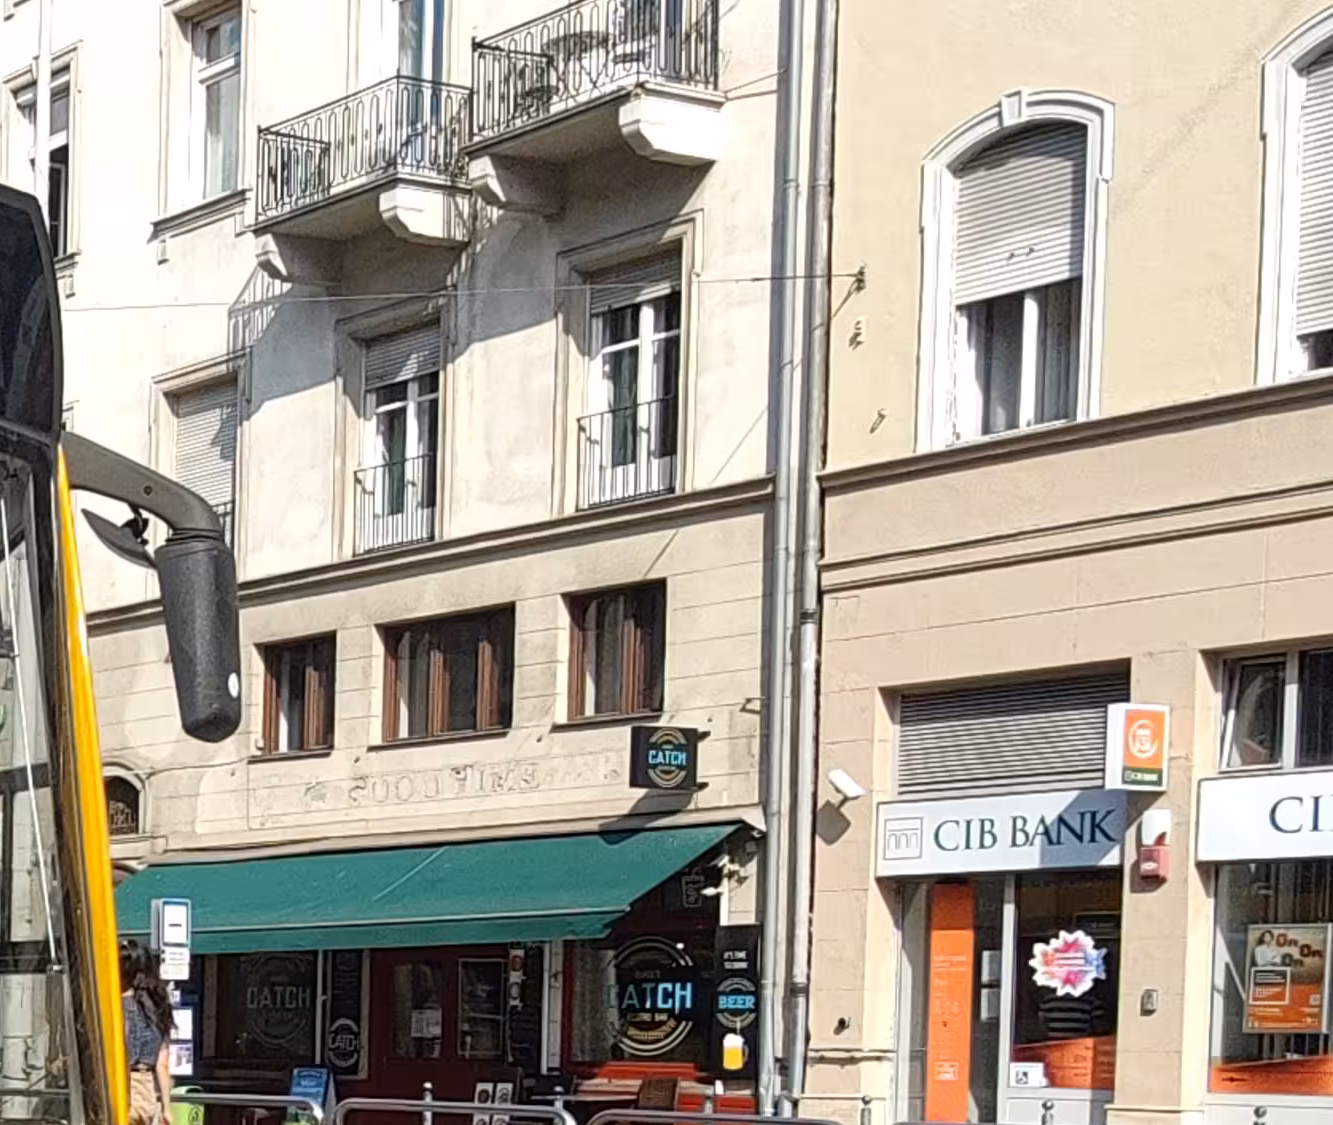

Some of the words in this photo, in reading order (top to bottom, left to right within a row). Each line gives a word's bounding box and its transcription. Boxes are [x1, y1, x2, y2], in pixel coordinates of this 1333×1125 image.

[648, 750, 687, 765] CATCH
[1268, 794, 1333, 834] CI
[933, 817, 998, 852] CIB
[1009, 808, 1118, 849] BANK
[246, 986, 312, 1010] CATCH
[604, 981, 693, 1010] CATCH
[718, 994, 757, 1009] BEER
